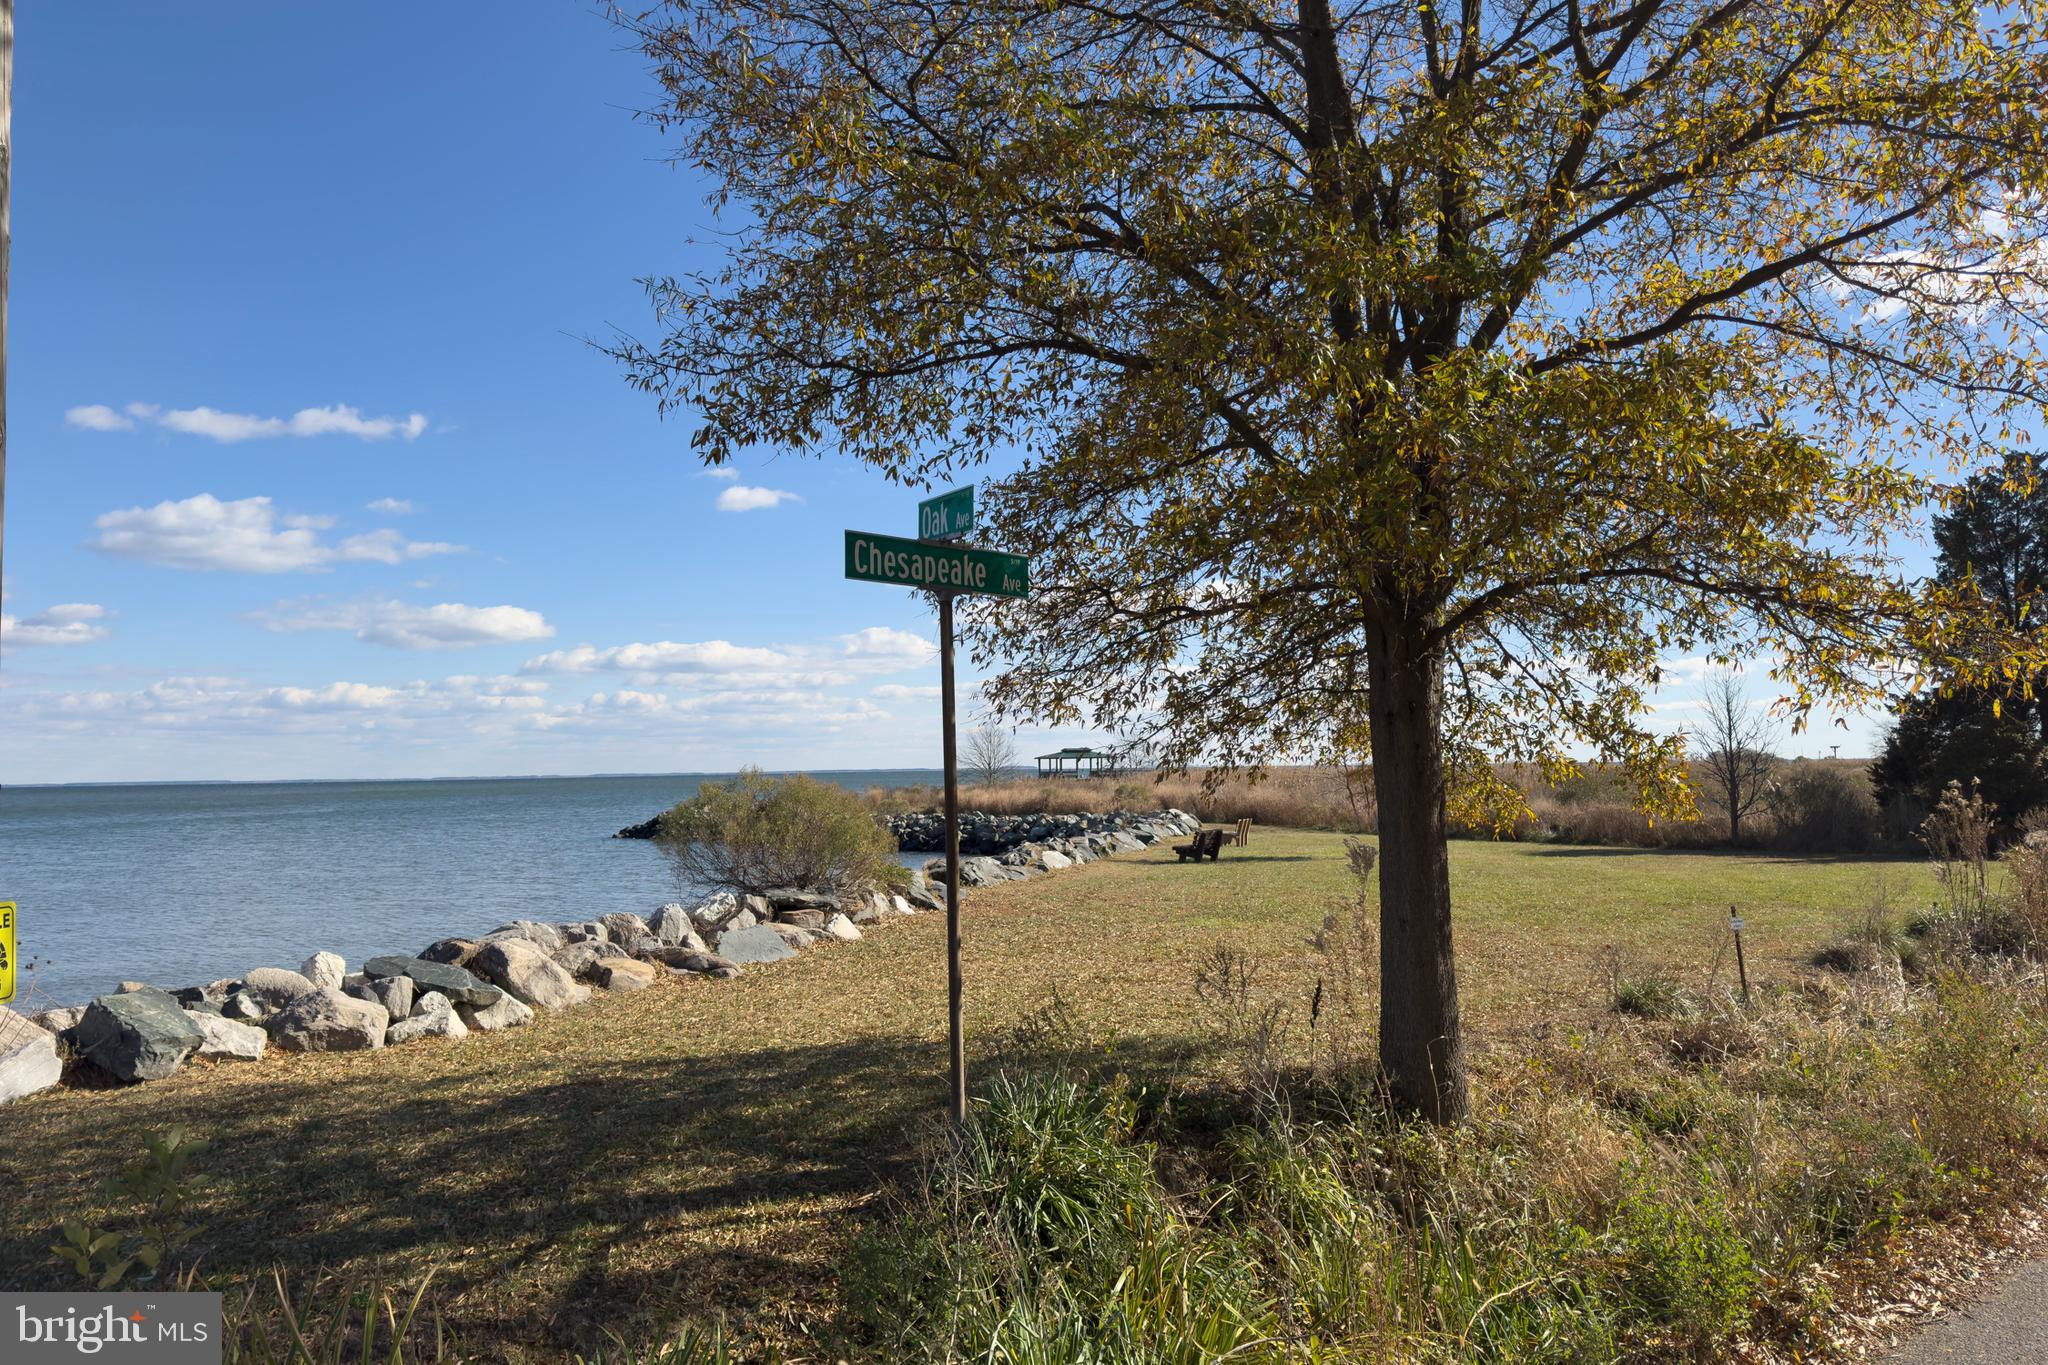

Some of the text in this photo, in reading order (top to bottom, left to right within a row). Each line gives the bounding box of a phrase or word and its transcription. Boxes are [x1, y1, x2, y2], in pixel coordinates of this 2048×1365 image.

[922, 501, 971, 539] Oak Ave
[854, 539, 1021, 592] Chesapeake Ave
